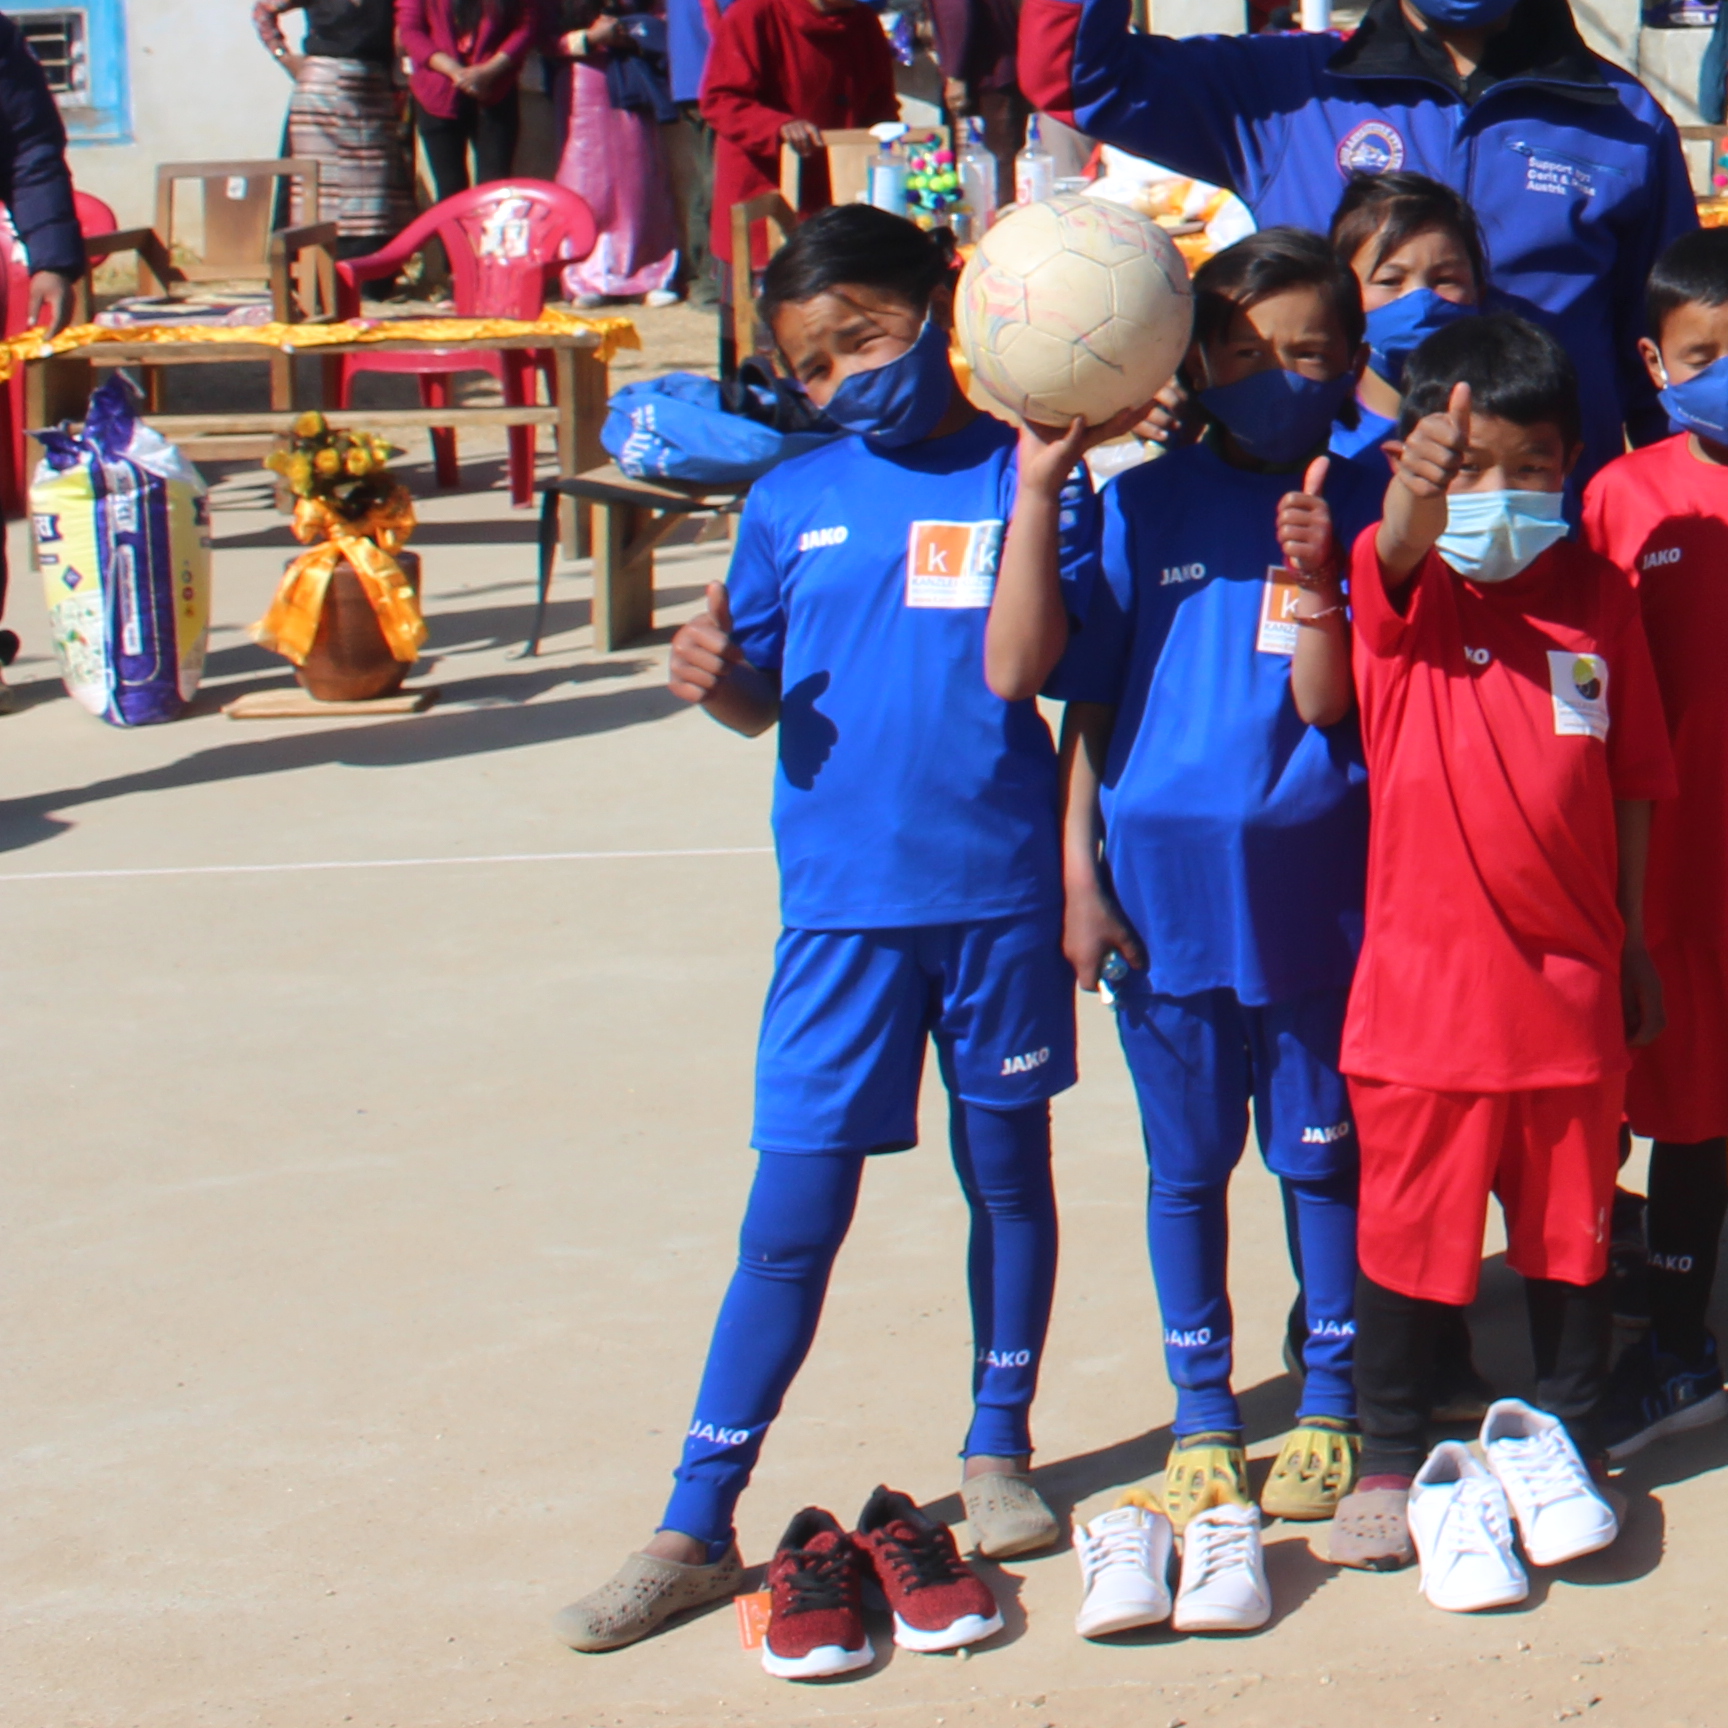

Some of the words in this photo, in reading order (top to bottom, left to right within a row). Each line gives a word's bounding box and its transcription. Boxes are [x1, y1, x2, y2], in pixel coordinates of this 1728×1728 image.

[1529, 156, 1572, 174] Support
[798, 525, 849, 552] JAKO
[1001, 1046, 1050, 1075] JAKO
[1301, 1121, 1349, 1145] JAKO
[1645, 1252, 1693, 1273] AKO
[1312, 1319, 1356, 1337] JAK
[689, 1420, 750, 1445] JAKO
